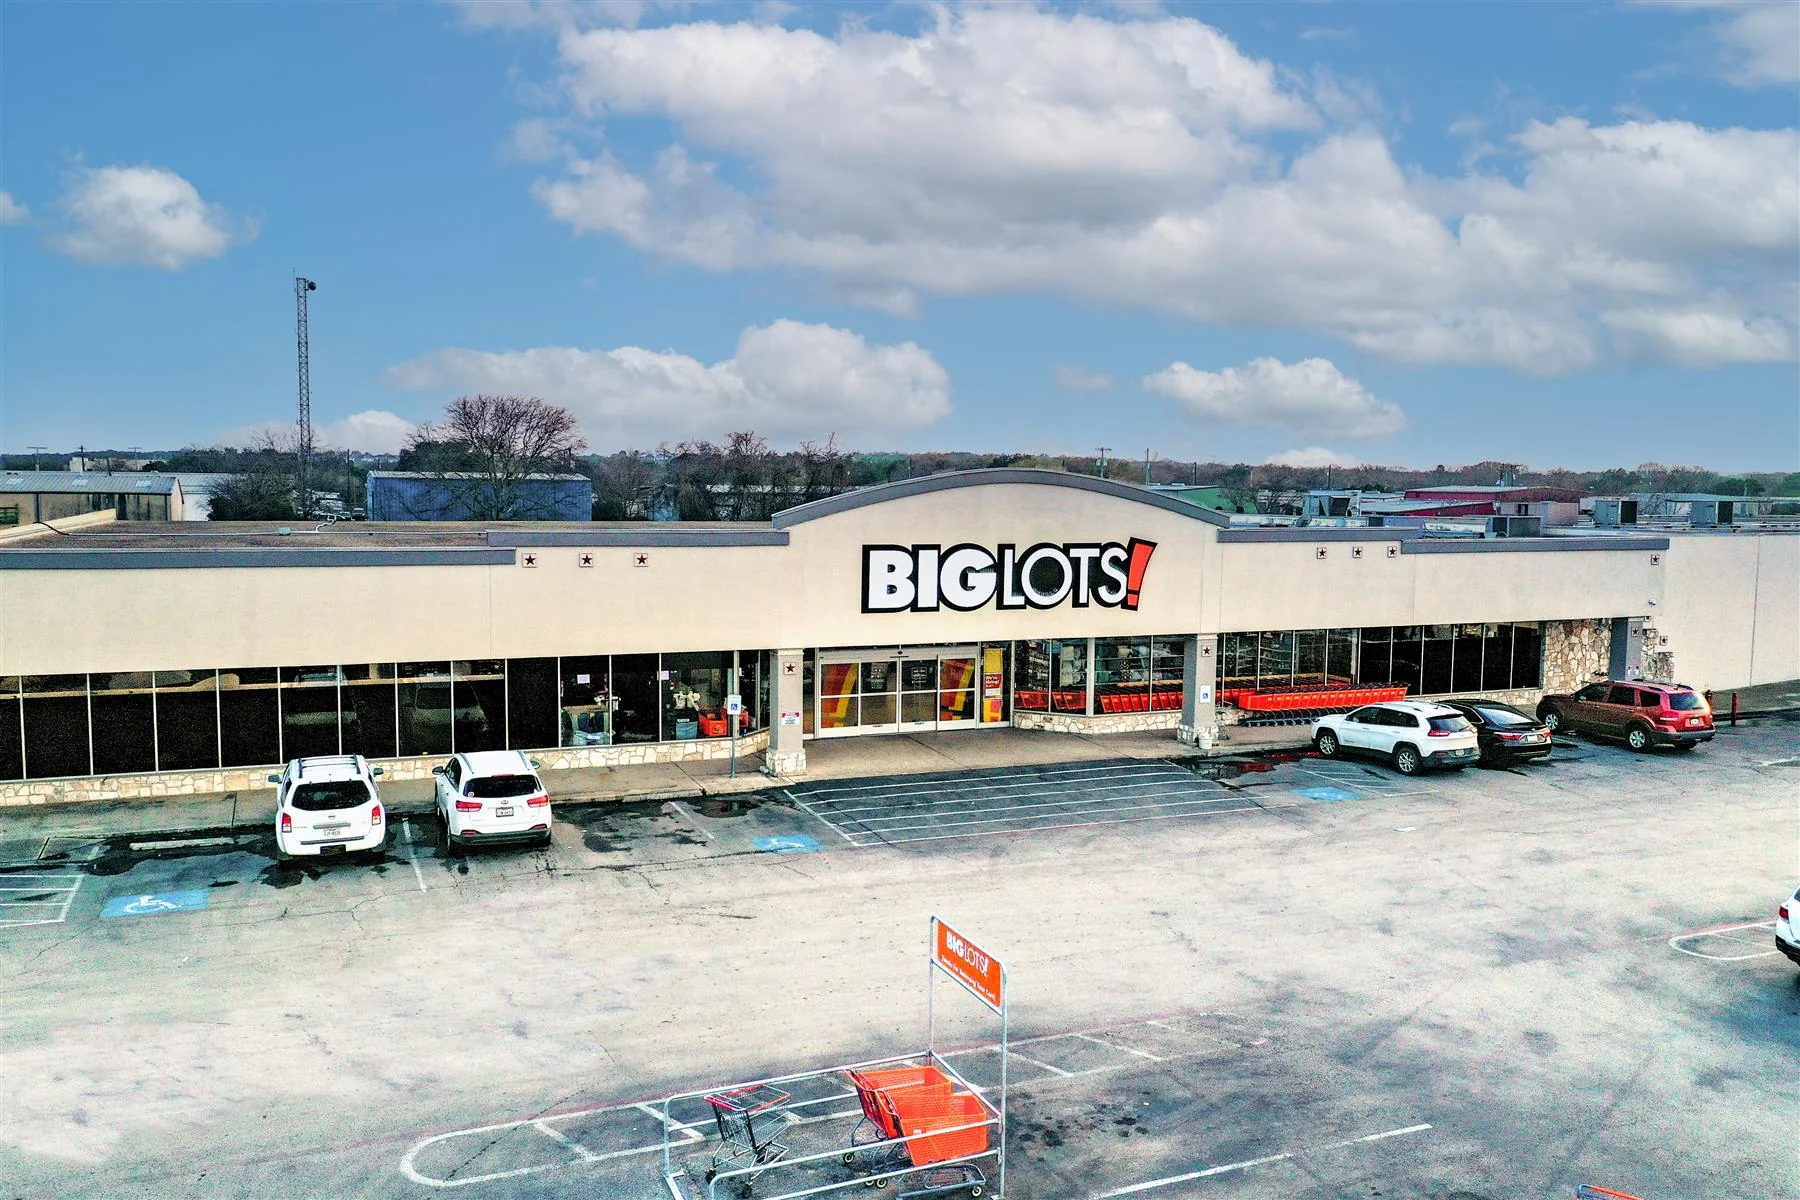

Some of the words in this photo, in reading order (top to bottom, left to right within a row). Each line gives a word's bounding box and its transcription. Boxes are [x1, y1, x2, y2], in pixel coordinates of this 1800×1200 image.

[862, 543, 997, 613] BIG
[996, 537, 1157, 611] LOTS!
[946, 930, 965, 958] BIG
[964, 943, 990, 978] LOTS!
